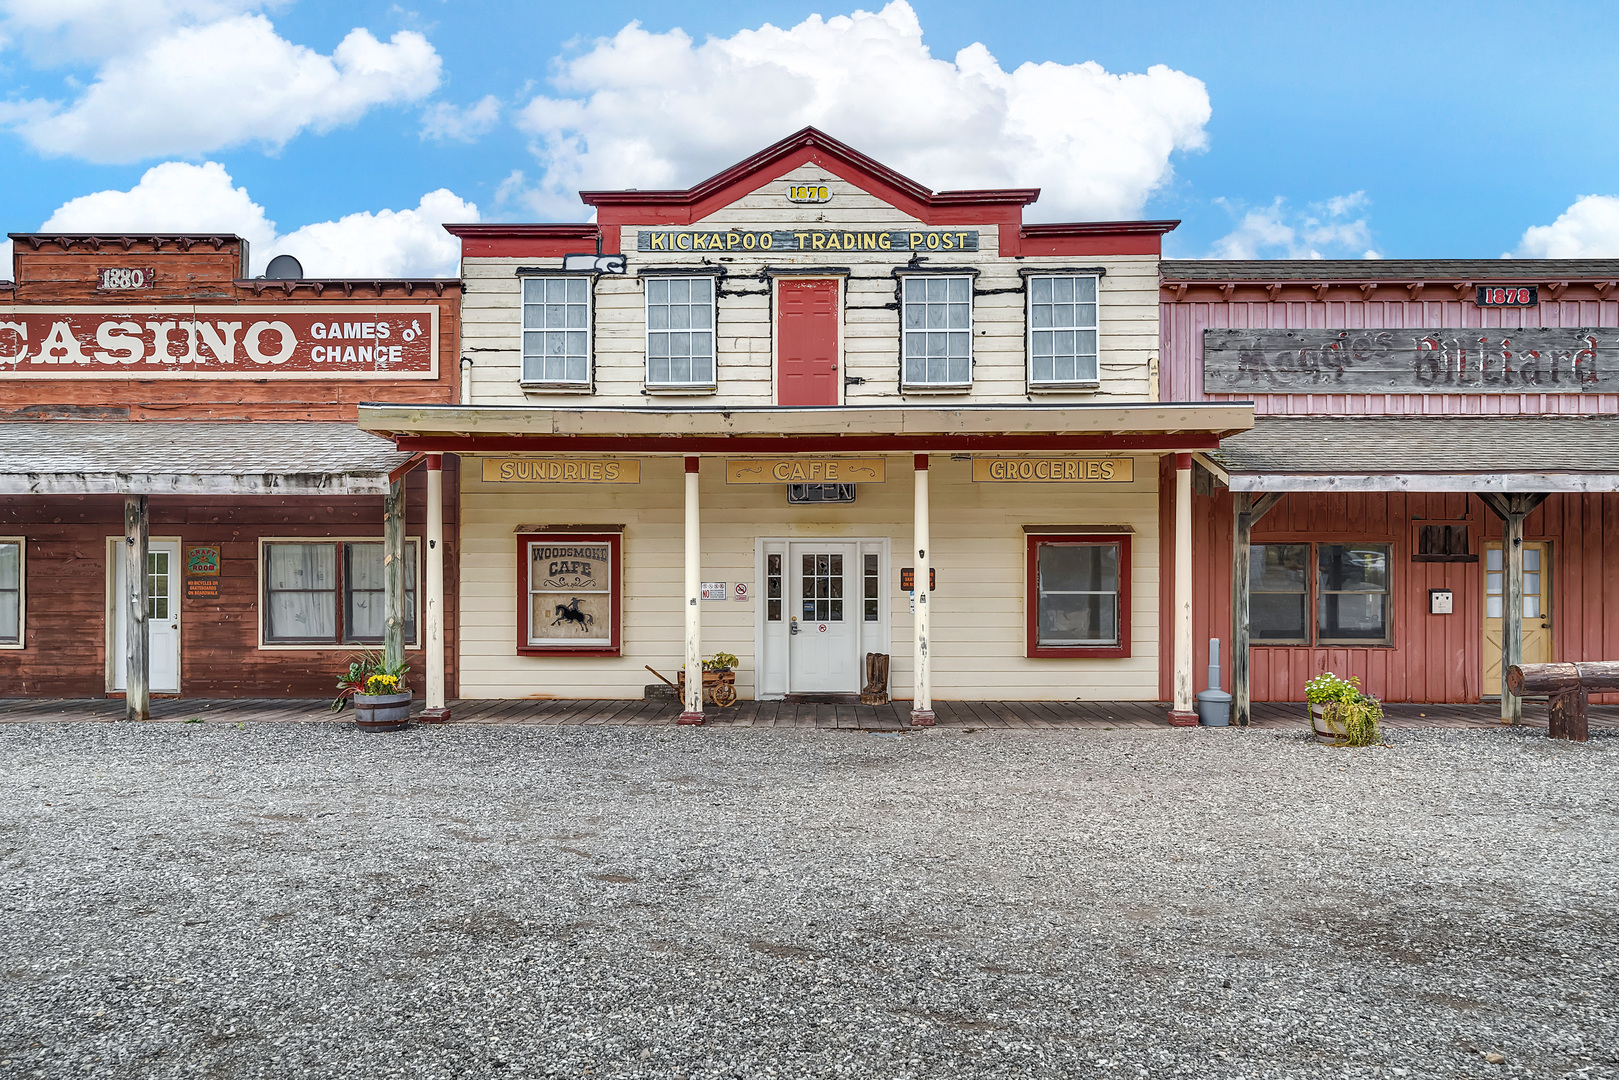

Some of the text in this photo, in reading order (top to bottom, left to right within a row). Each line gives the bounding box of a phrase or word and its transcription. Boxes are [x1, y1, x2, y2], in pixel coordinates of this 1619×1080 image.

[791, 186, 828, 200] 1876
[650, 232, 968, 250] KICKAPOO TRADING POST
[103, 268, 144, 288] 1880
[1485, 288, 1530, 304] 1878
[310, 319, 423, 342] GAMES of
[0, 321, 299, 364] CASINO
[311, 345, 403, 363] CHANCE
[500, 461, 620, 480] SUNDRIES
[773, 461, 838, 480] CAFE
[989, 460, 1115, 480] GROCERIES
[190, 549, 217, 558] CRAFT
[532, 547, 608, 562] WOODSMOKE
[549, 561, 592, 577] CAFE
